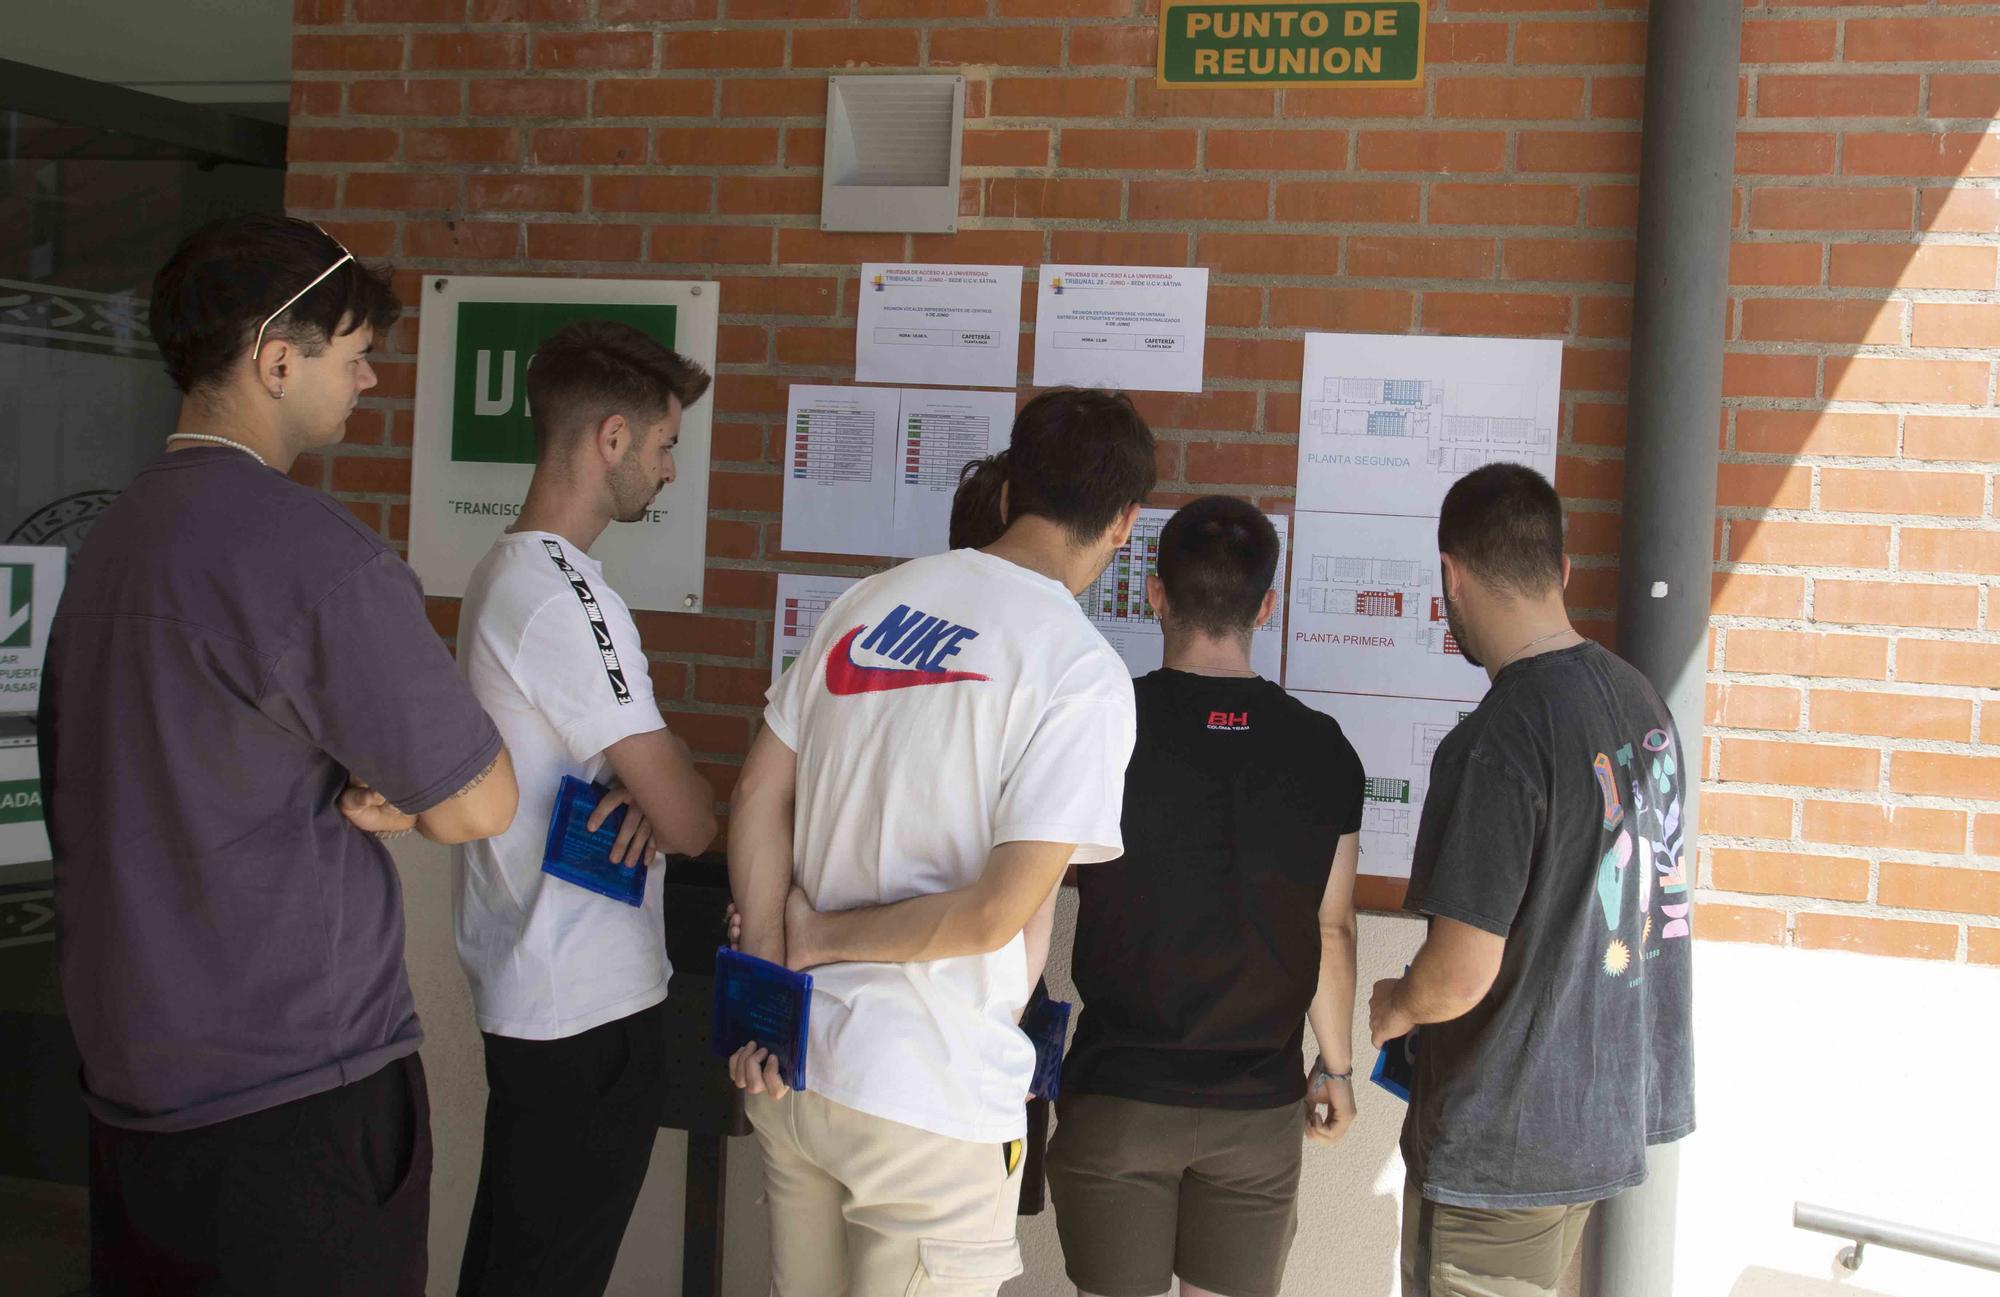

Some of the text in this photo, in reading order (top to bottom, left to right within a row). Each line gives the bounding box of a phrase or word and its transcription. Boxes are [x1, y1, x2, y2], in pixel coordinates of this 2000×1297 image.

[1186, 9, 1398, 39] PUNTO DE
[1194, 47, 1382, 75] REUNION
[1145, 337, 1175, 345] CAFETERÍA
[1307, 453, 1410, 467] PLANTA SEGUNDA
[584, 600, 603, 623] NIKE
[860, 604, 980, 673] NIKE
[1296, 632, 1395, 647] PLANTA PRIMERA
[601, 648, 620, 671] NIKE
[1207, 711, 1249, 726] BH
